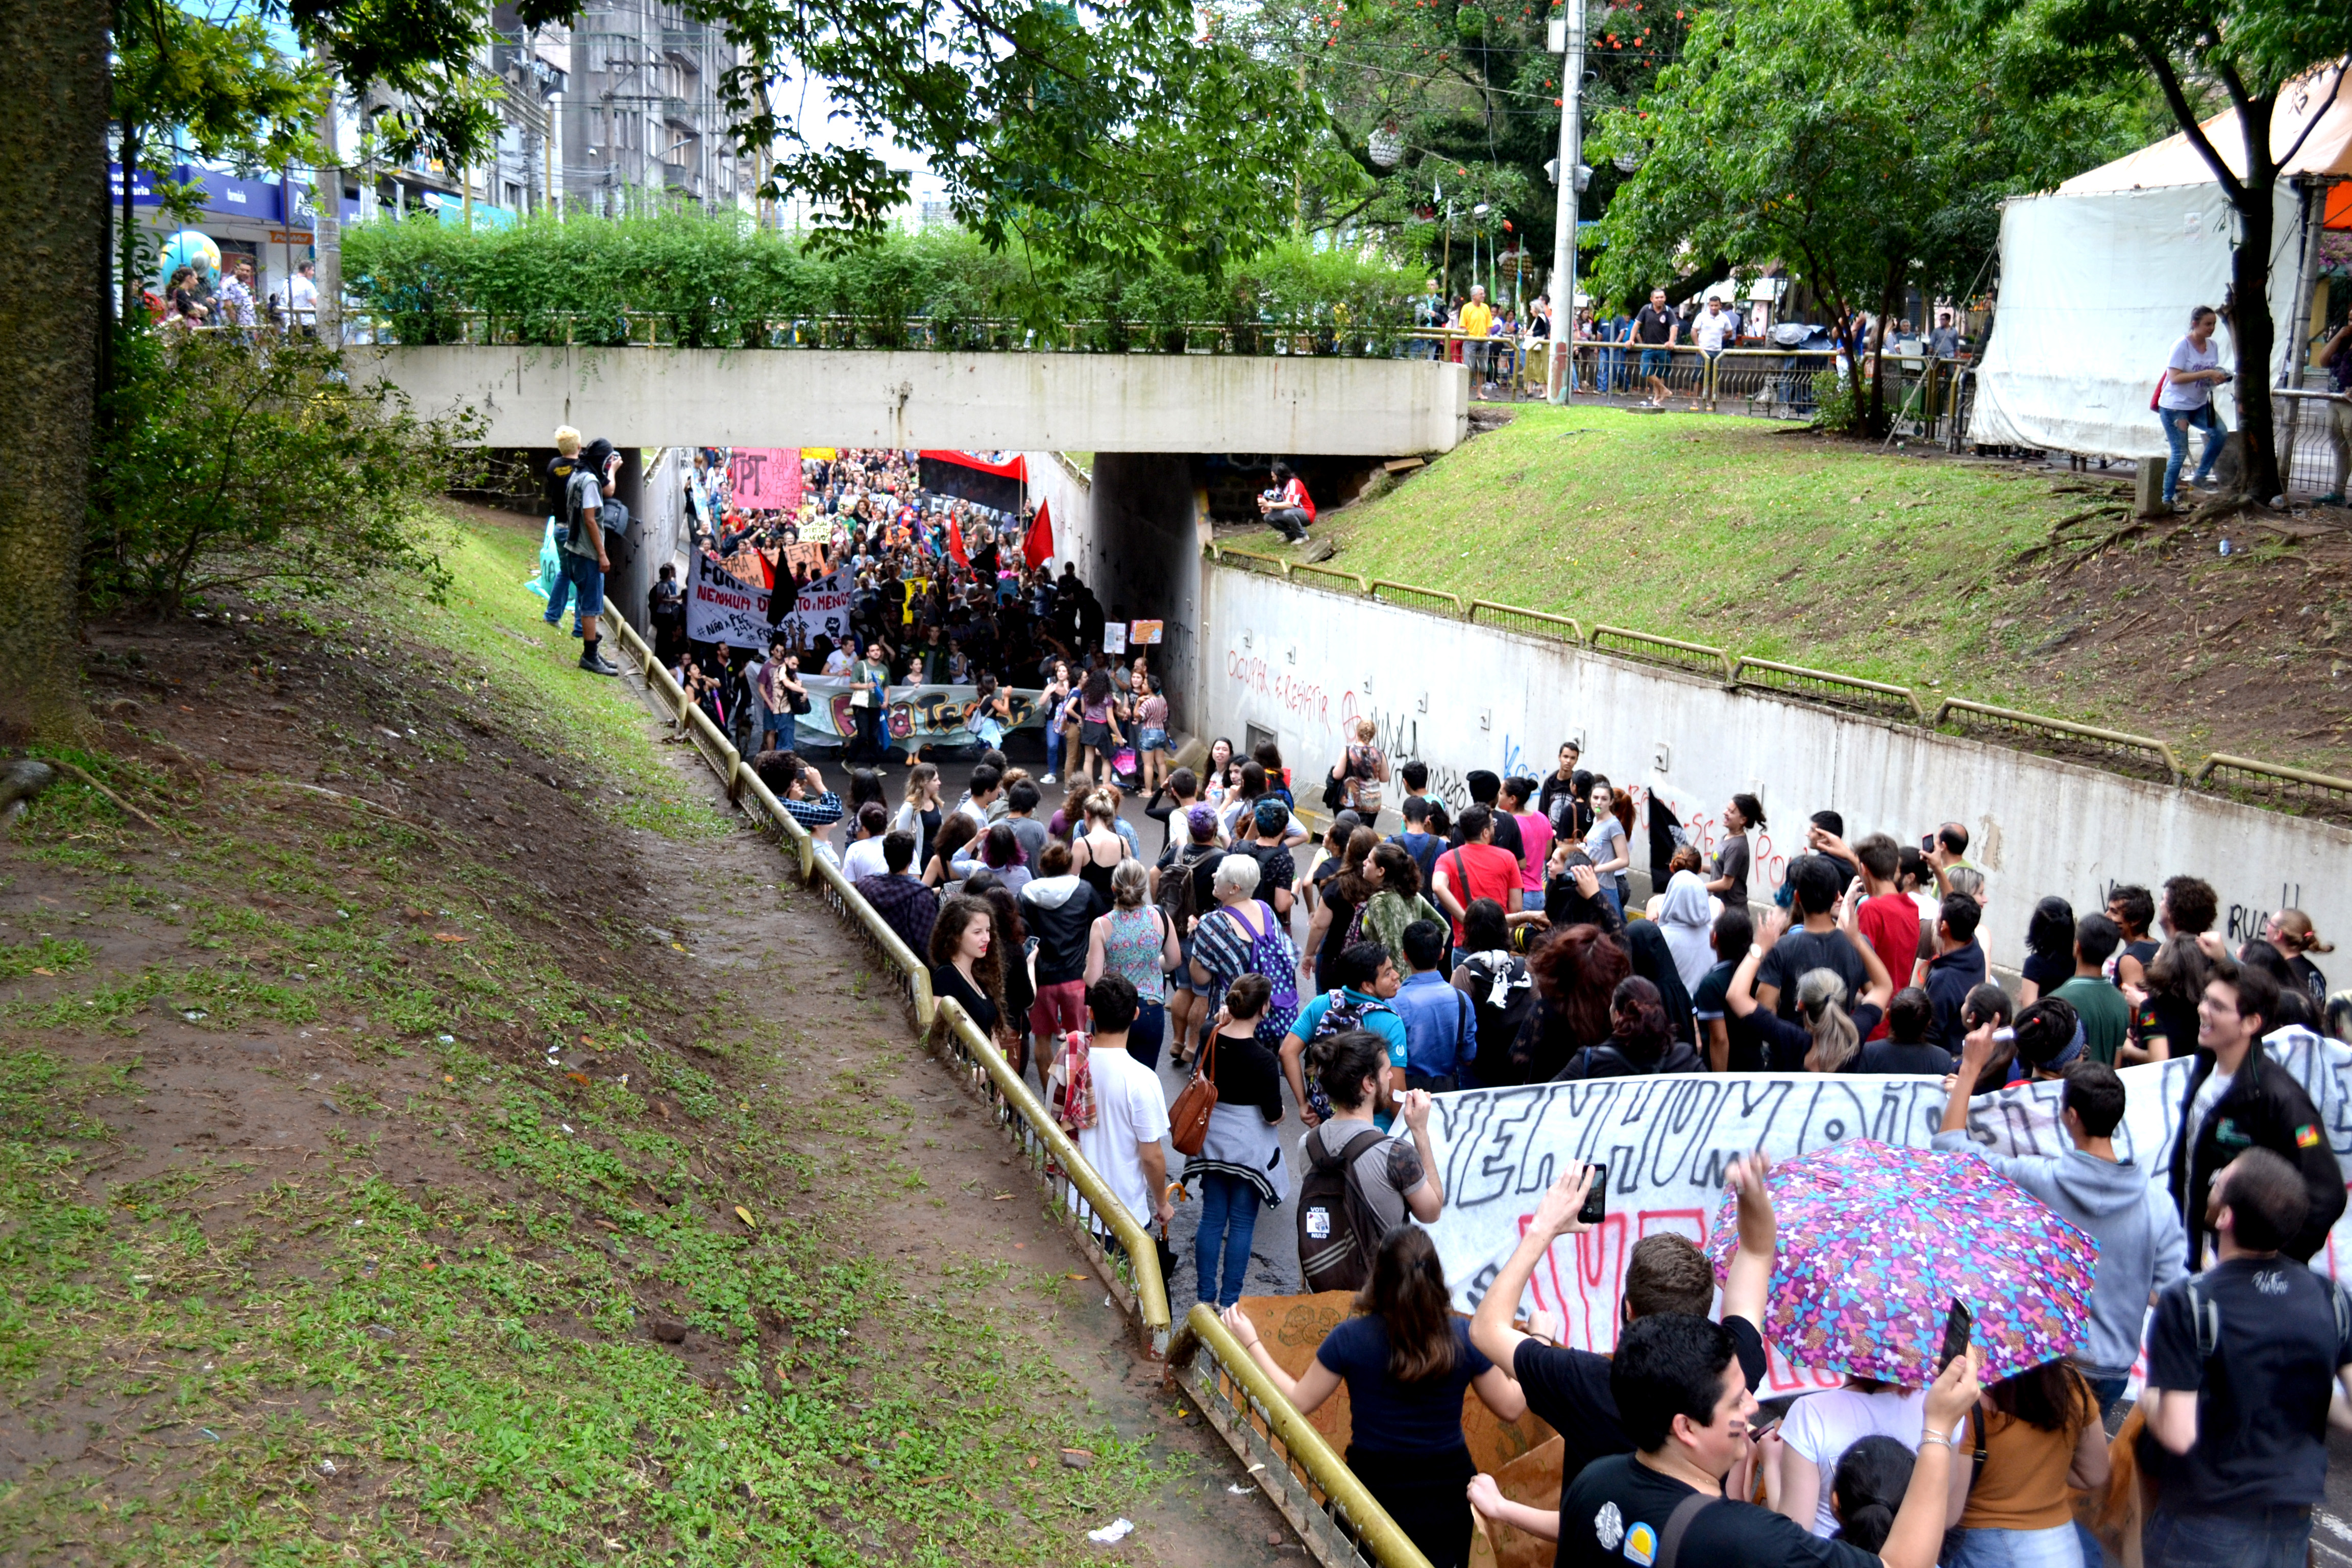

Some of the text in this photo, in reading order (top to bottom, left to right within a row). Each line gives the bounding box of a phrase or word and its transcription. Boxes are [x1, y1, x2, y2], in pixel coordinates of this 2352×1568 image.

[772, 465, 789, 481] PEC
[775, 481, 802, 495] FORA
[697, 584, 751, 611] NENHUM
[817, 591, 851, 611] MENOS
[729, 613, 749, 626] PEC
[1228, 650, 1270, 697] OCUPAR
